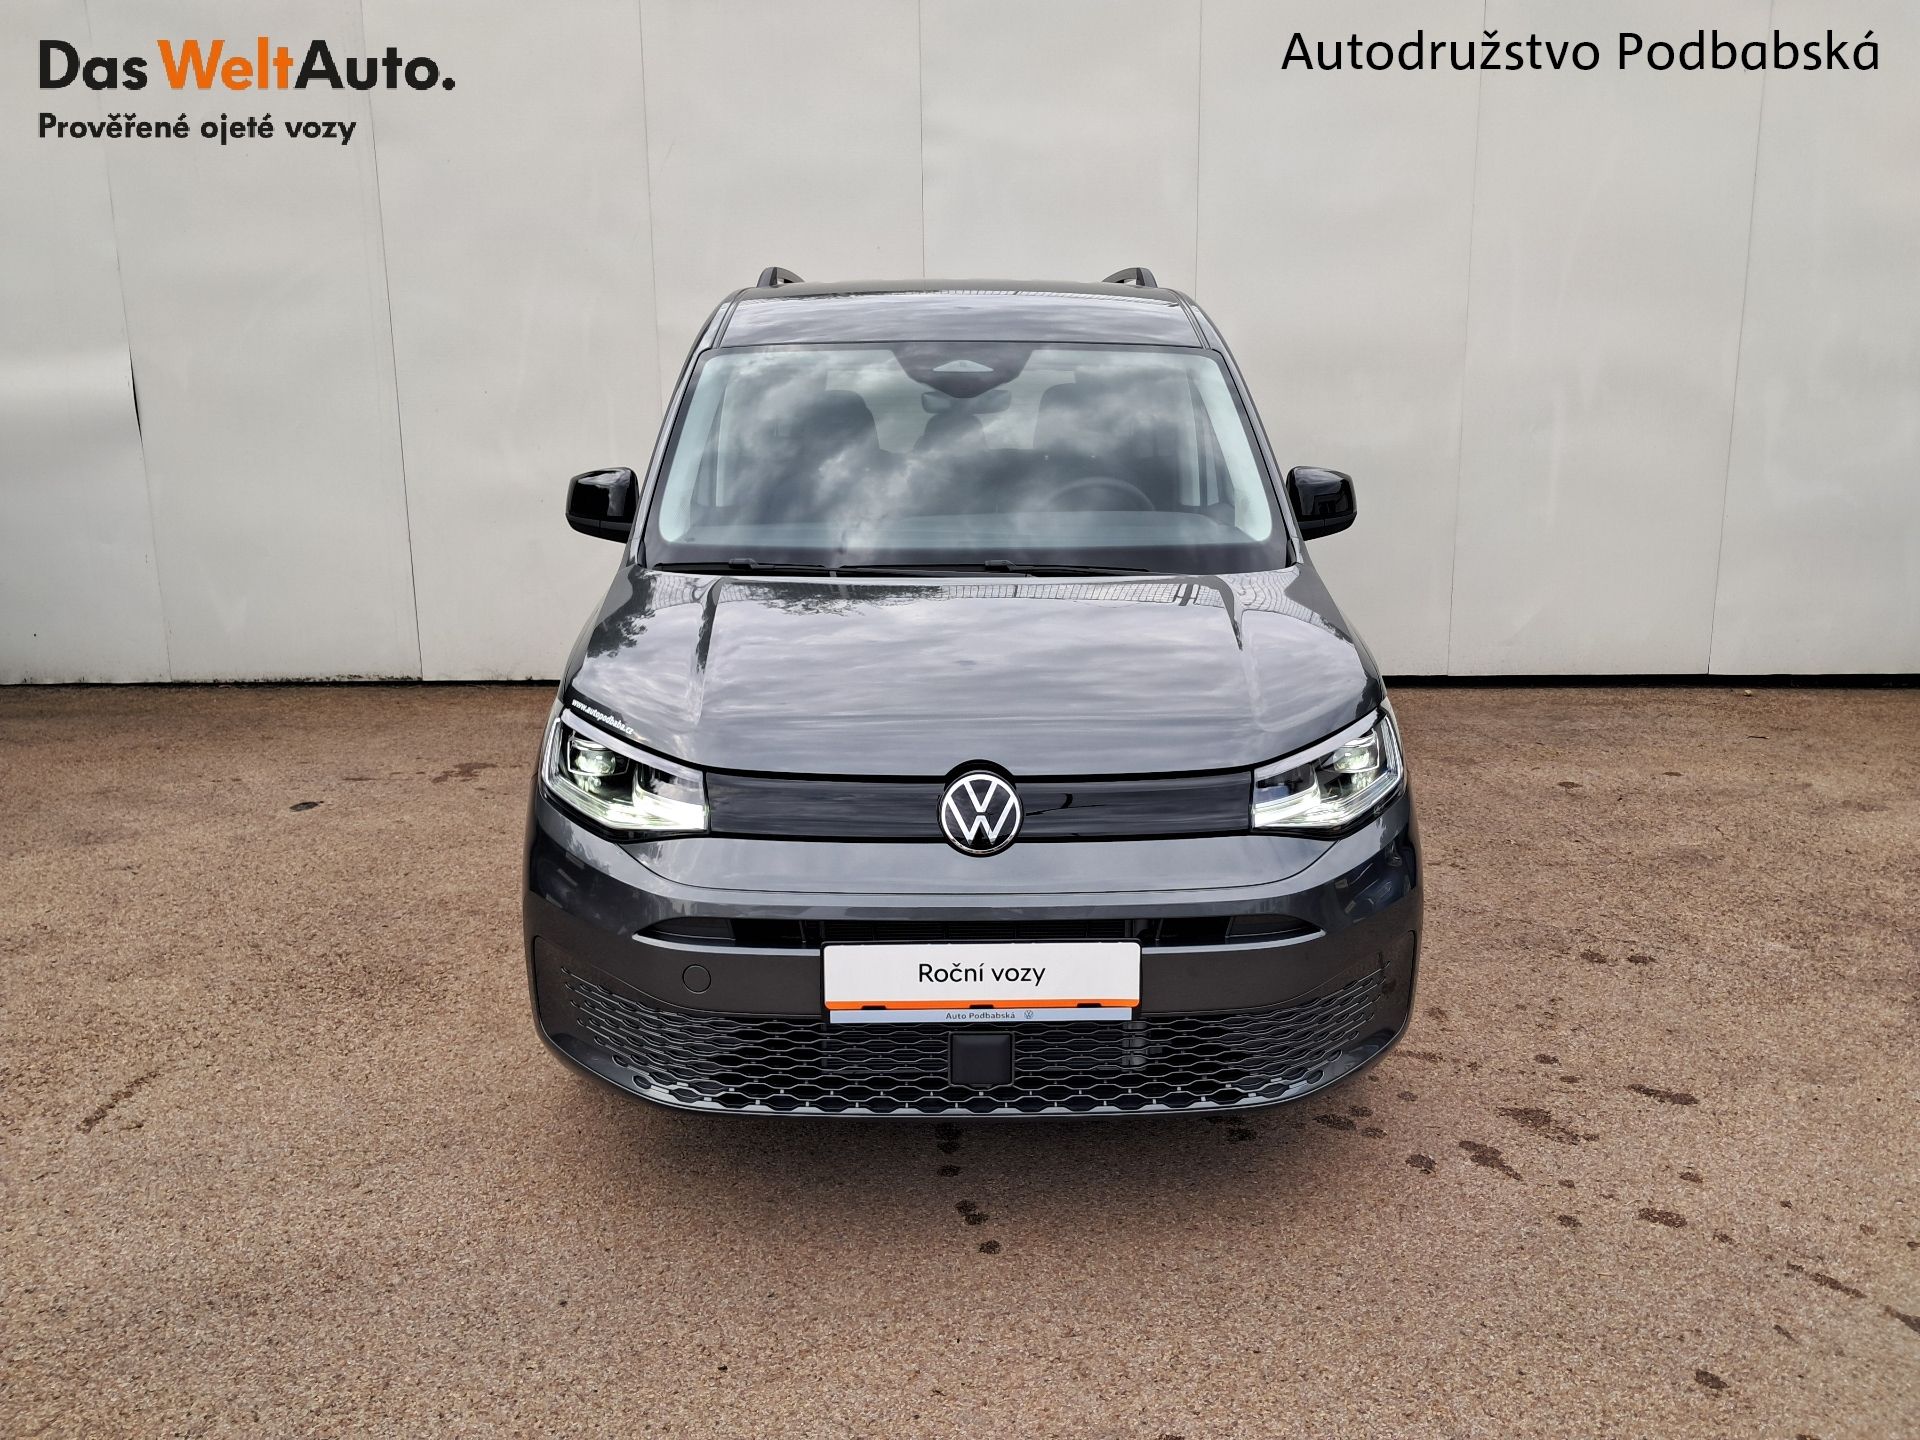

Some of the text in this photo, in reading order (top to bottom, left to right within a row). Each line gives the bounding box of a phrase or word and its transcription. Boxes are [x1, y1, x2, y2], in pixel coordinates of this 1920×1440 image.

[571, 699, 634, 734] www.autopodbaba.cz
[918, 962, 1046, 987] Roční vozy
[945, 1012, 967, 1020] Auto
[968, 1011, 1016, 1020] Podbabská
